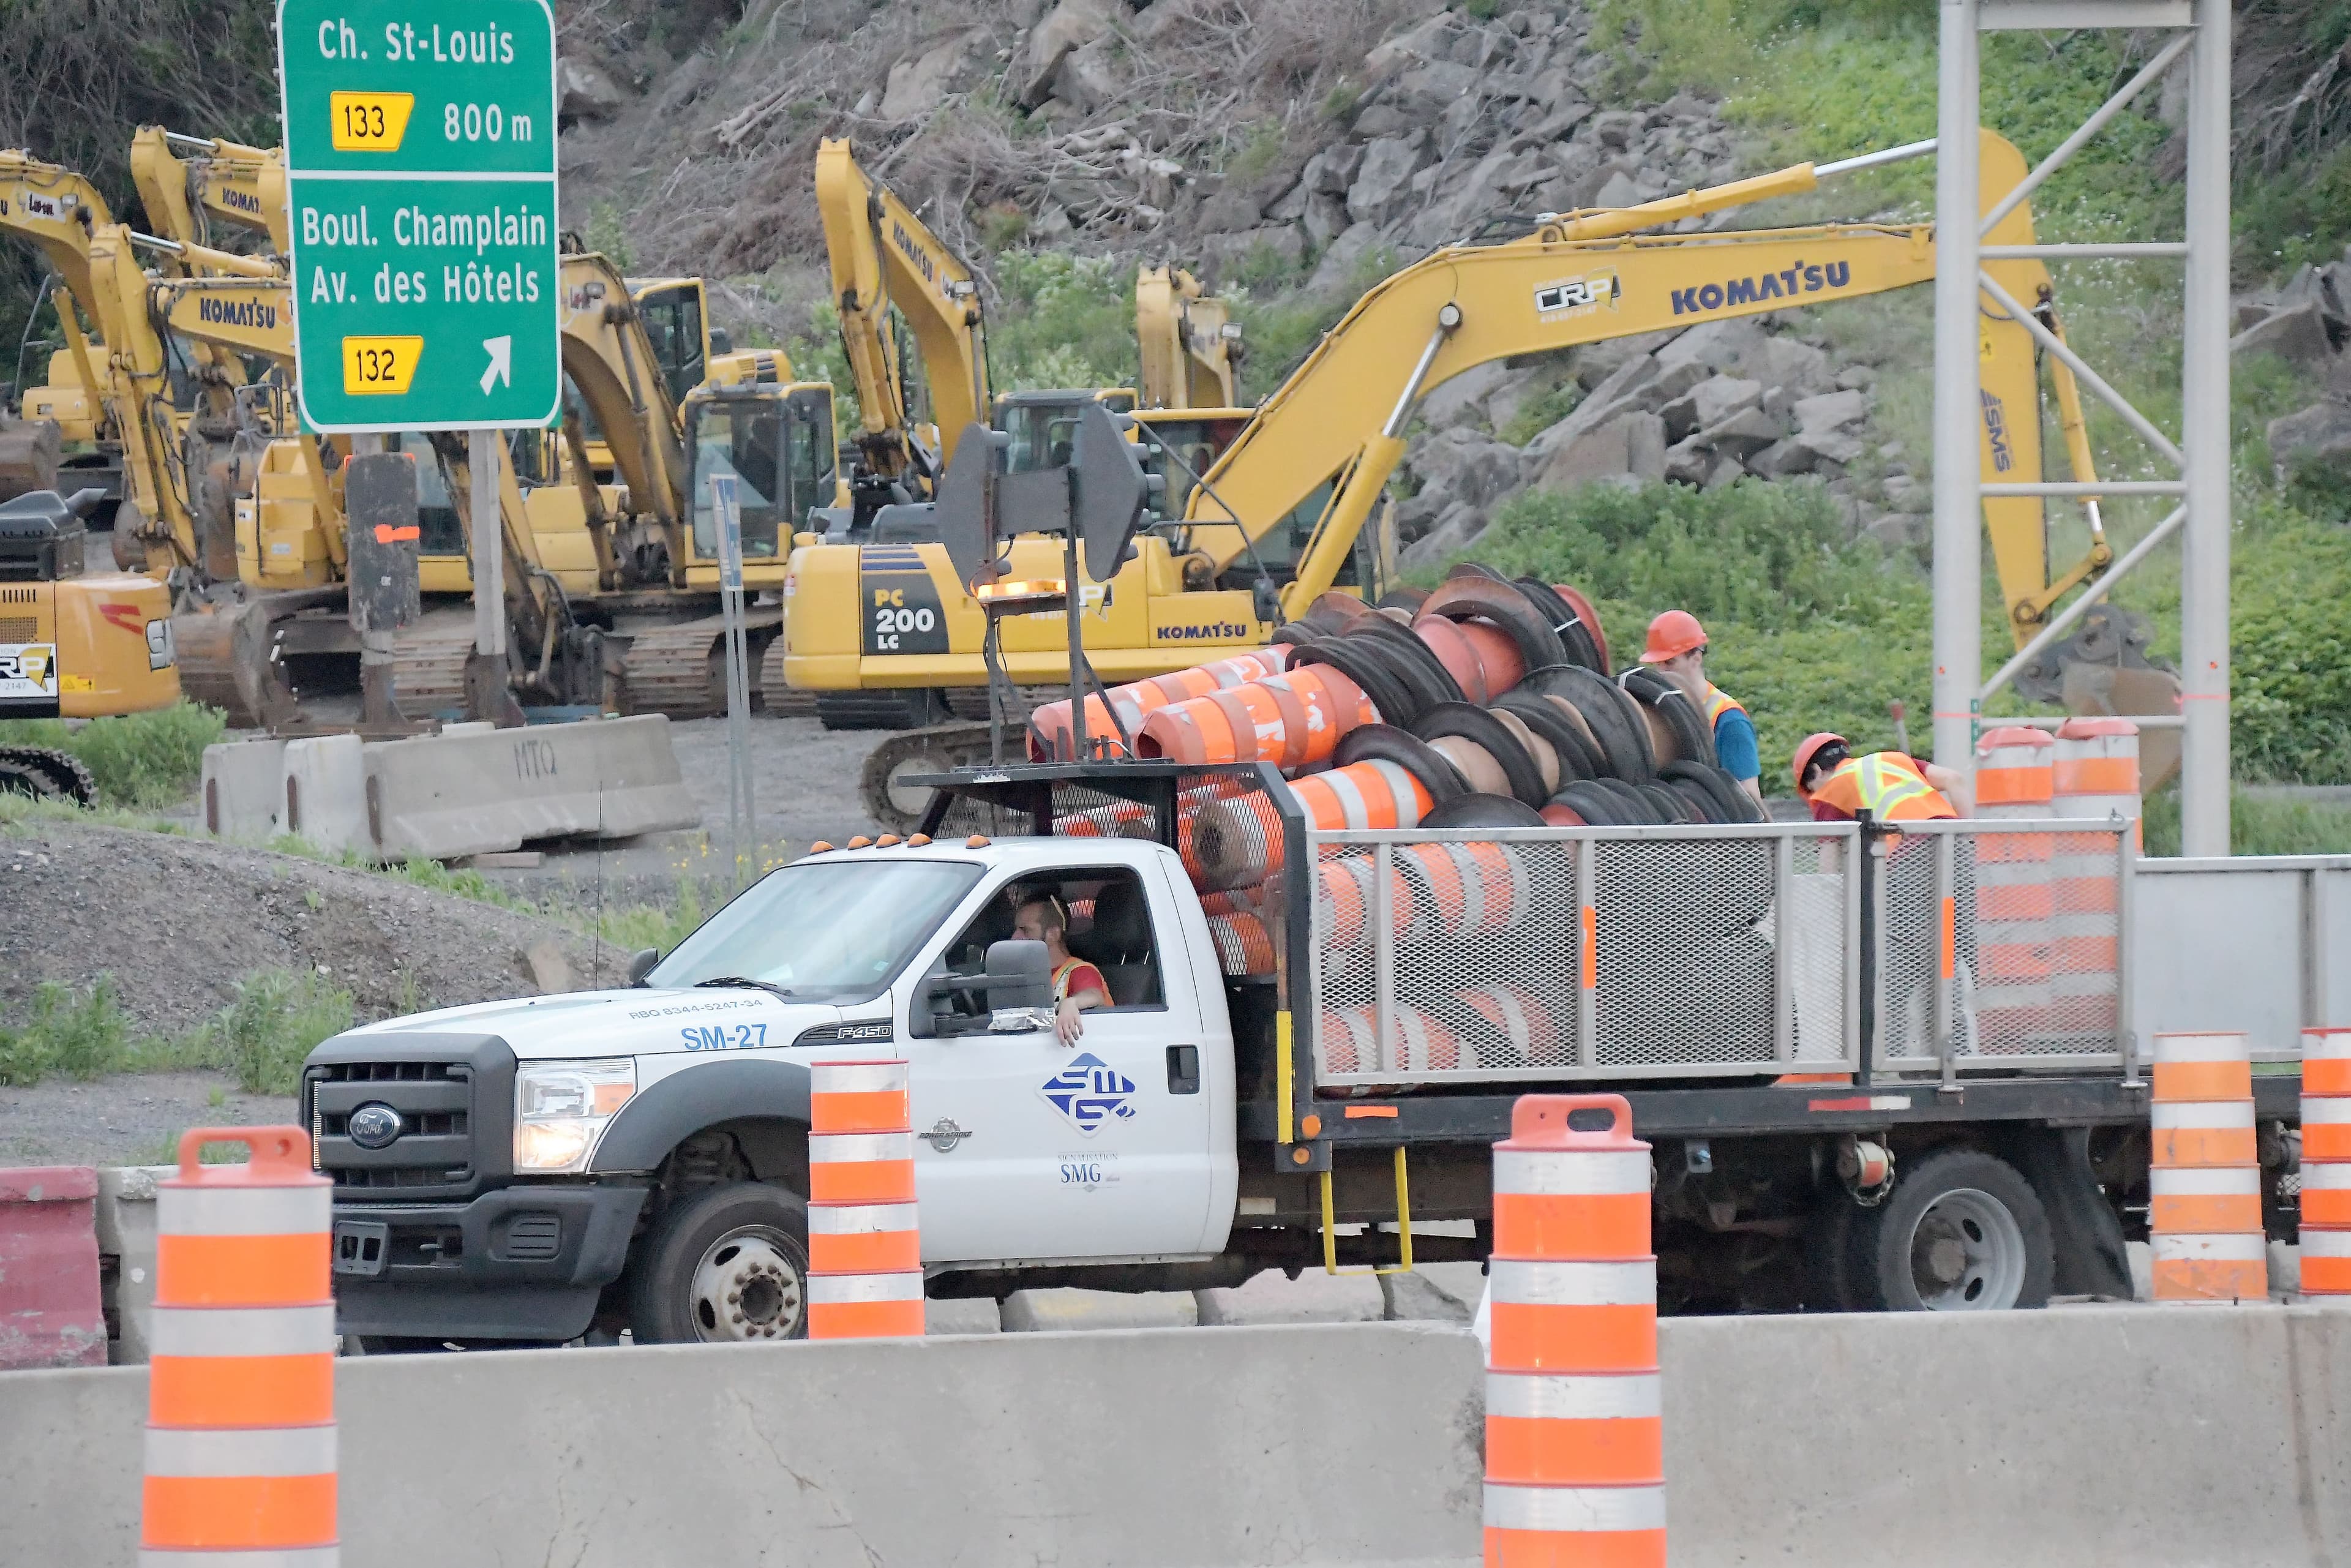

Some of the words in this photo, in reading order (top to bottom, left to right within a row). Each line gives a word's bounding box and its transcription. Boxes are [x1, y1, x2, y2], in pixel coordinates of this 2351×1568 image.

[318, 18, 367, 59] Ch.
[385, 21, 514, 64] St-Louis
[344, 105, 385, 138] 133
[444, 103, 502, 141] 800
[512, 114, 532, 141] m
[222, 186, 263, 214] KOMAT
[302, 205, 378, 246] Boul.
[394, 204, 546, 256] Champlain
[311, 265, 357, 303] Av.
[374, 263, 427, 303] des
[444, 261, 539, 303] Hôtels
[1671, 260, 1850, 315] KOMATSU
[200, 296, 275, 329] KOMATSU
[356, 349, 396, 381] 132
[874, 588, 904, 607] PC
[876, 608, 935, 633] 200
[1157, 620, 1247, 639] KOMATSU
[877, 634, 899, 650] LC
[514, 739, 557, 779] MTQ
[628, 1009, 661, 1019] RBQ
[662, 999, 763, 1015] 8344-5247-34
[681, 1023, 767, 1051] SM-27
[837, 1026, 893, 1039] F-450
[356, 1114, 384, 1135] Ford
[1060, 1163, 1101, 1183] SMG
